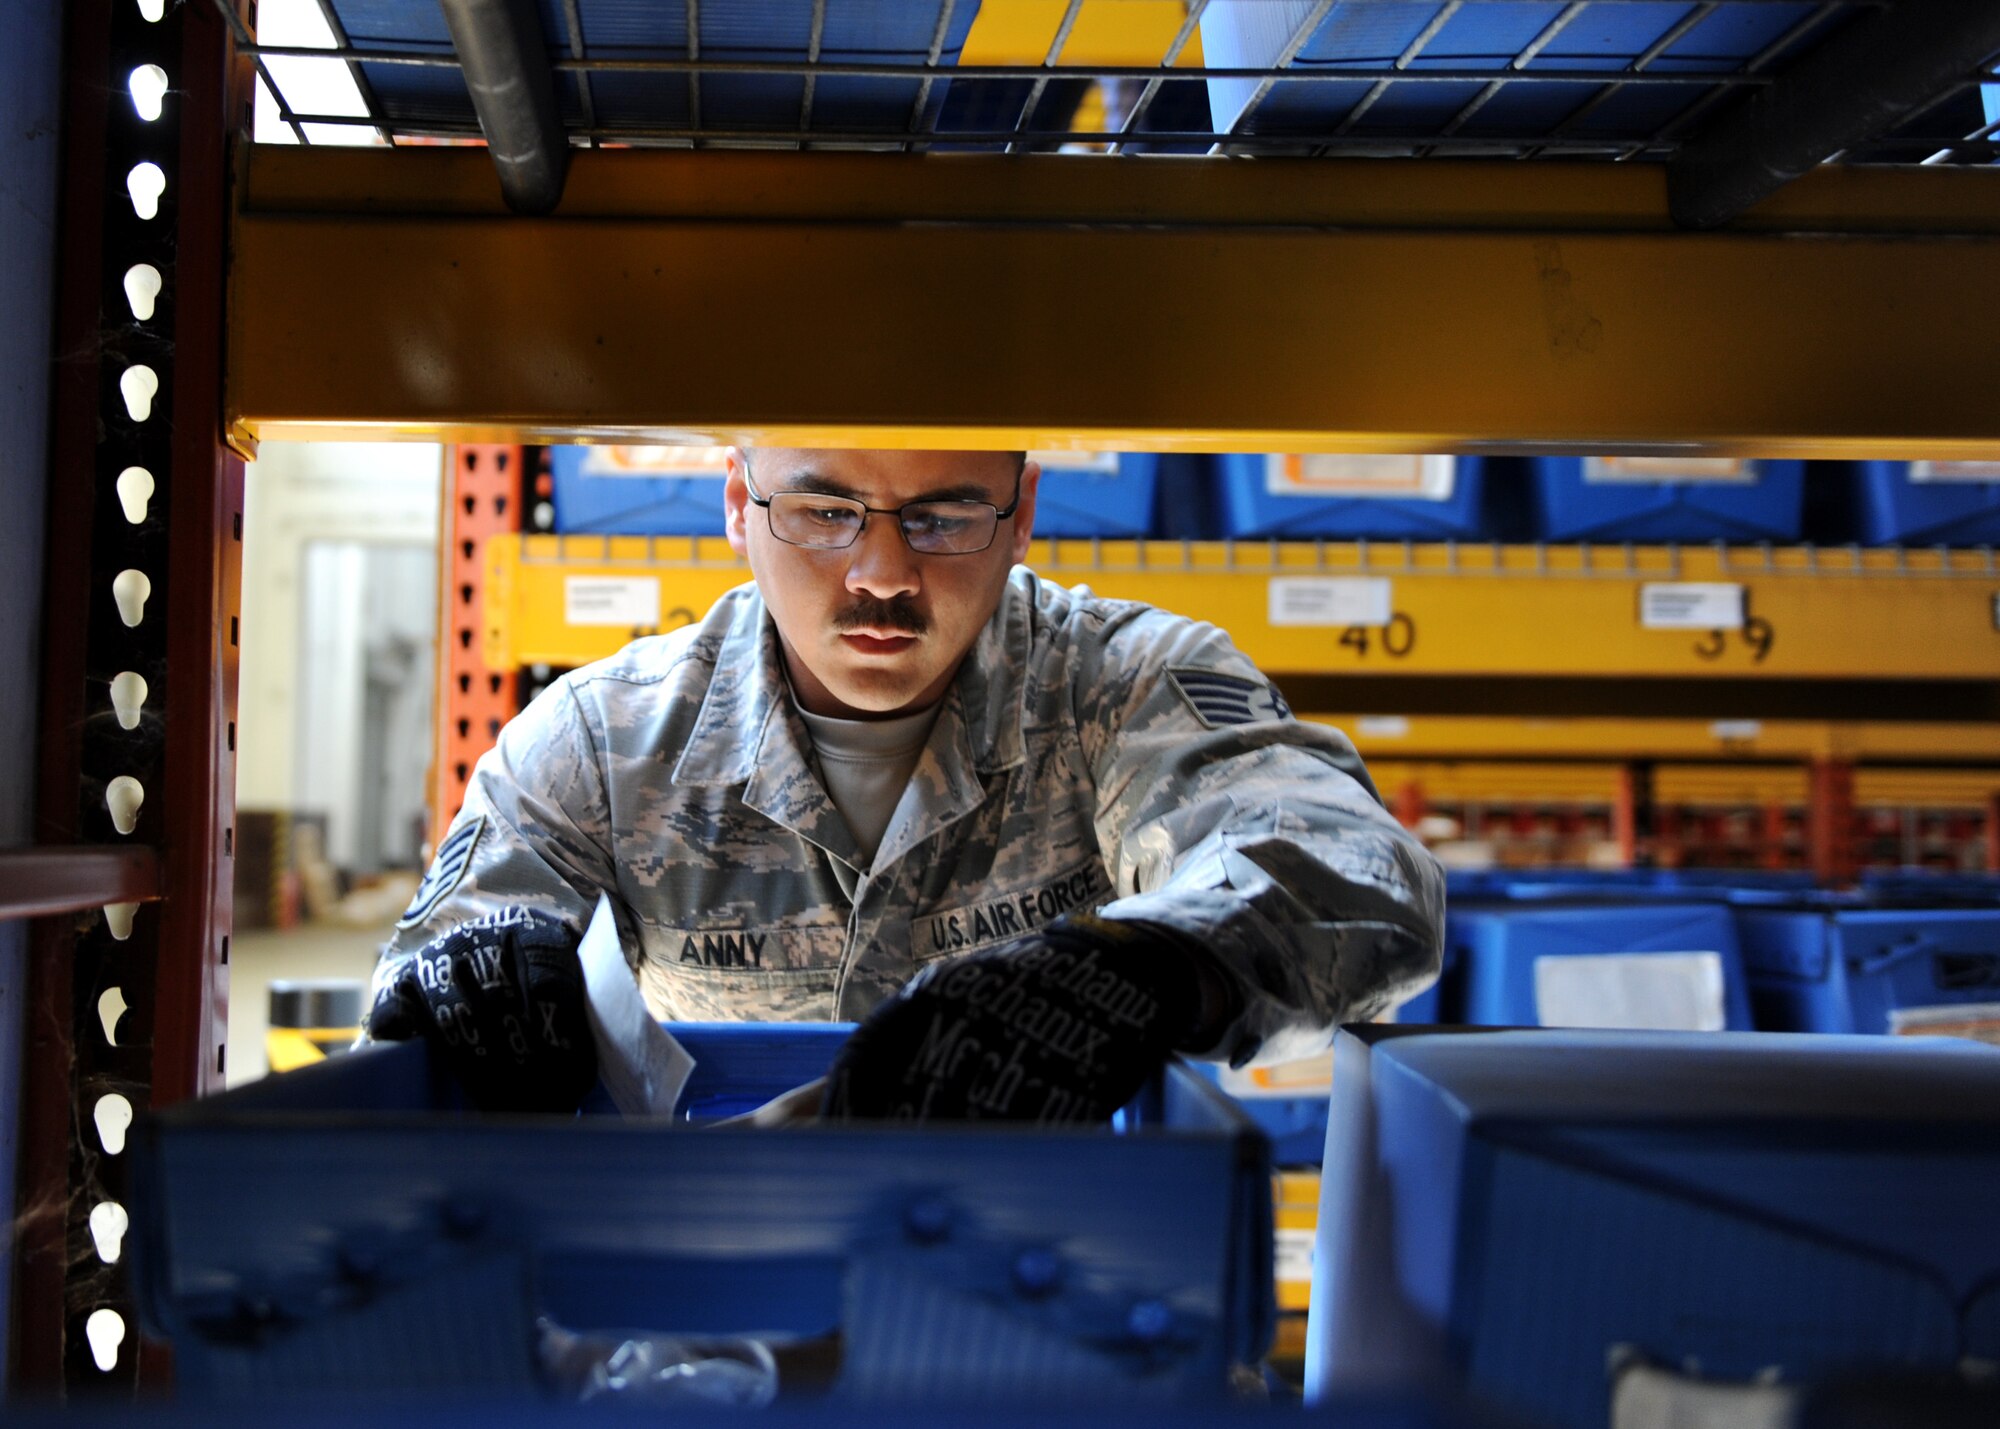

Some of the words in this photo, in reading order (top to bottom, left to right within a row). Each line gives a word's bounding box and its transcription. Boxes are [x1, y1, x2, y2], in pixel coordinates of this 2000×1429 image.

[1339, 612, 1416, 657] 40
[931, 915, 970, 951] U.S.
[974, 901, 1020, 942] AIR
[1019, 864, 1098, 929] FORCE
[680, 933, 766, 967] ANNY
